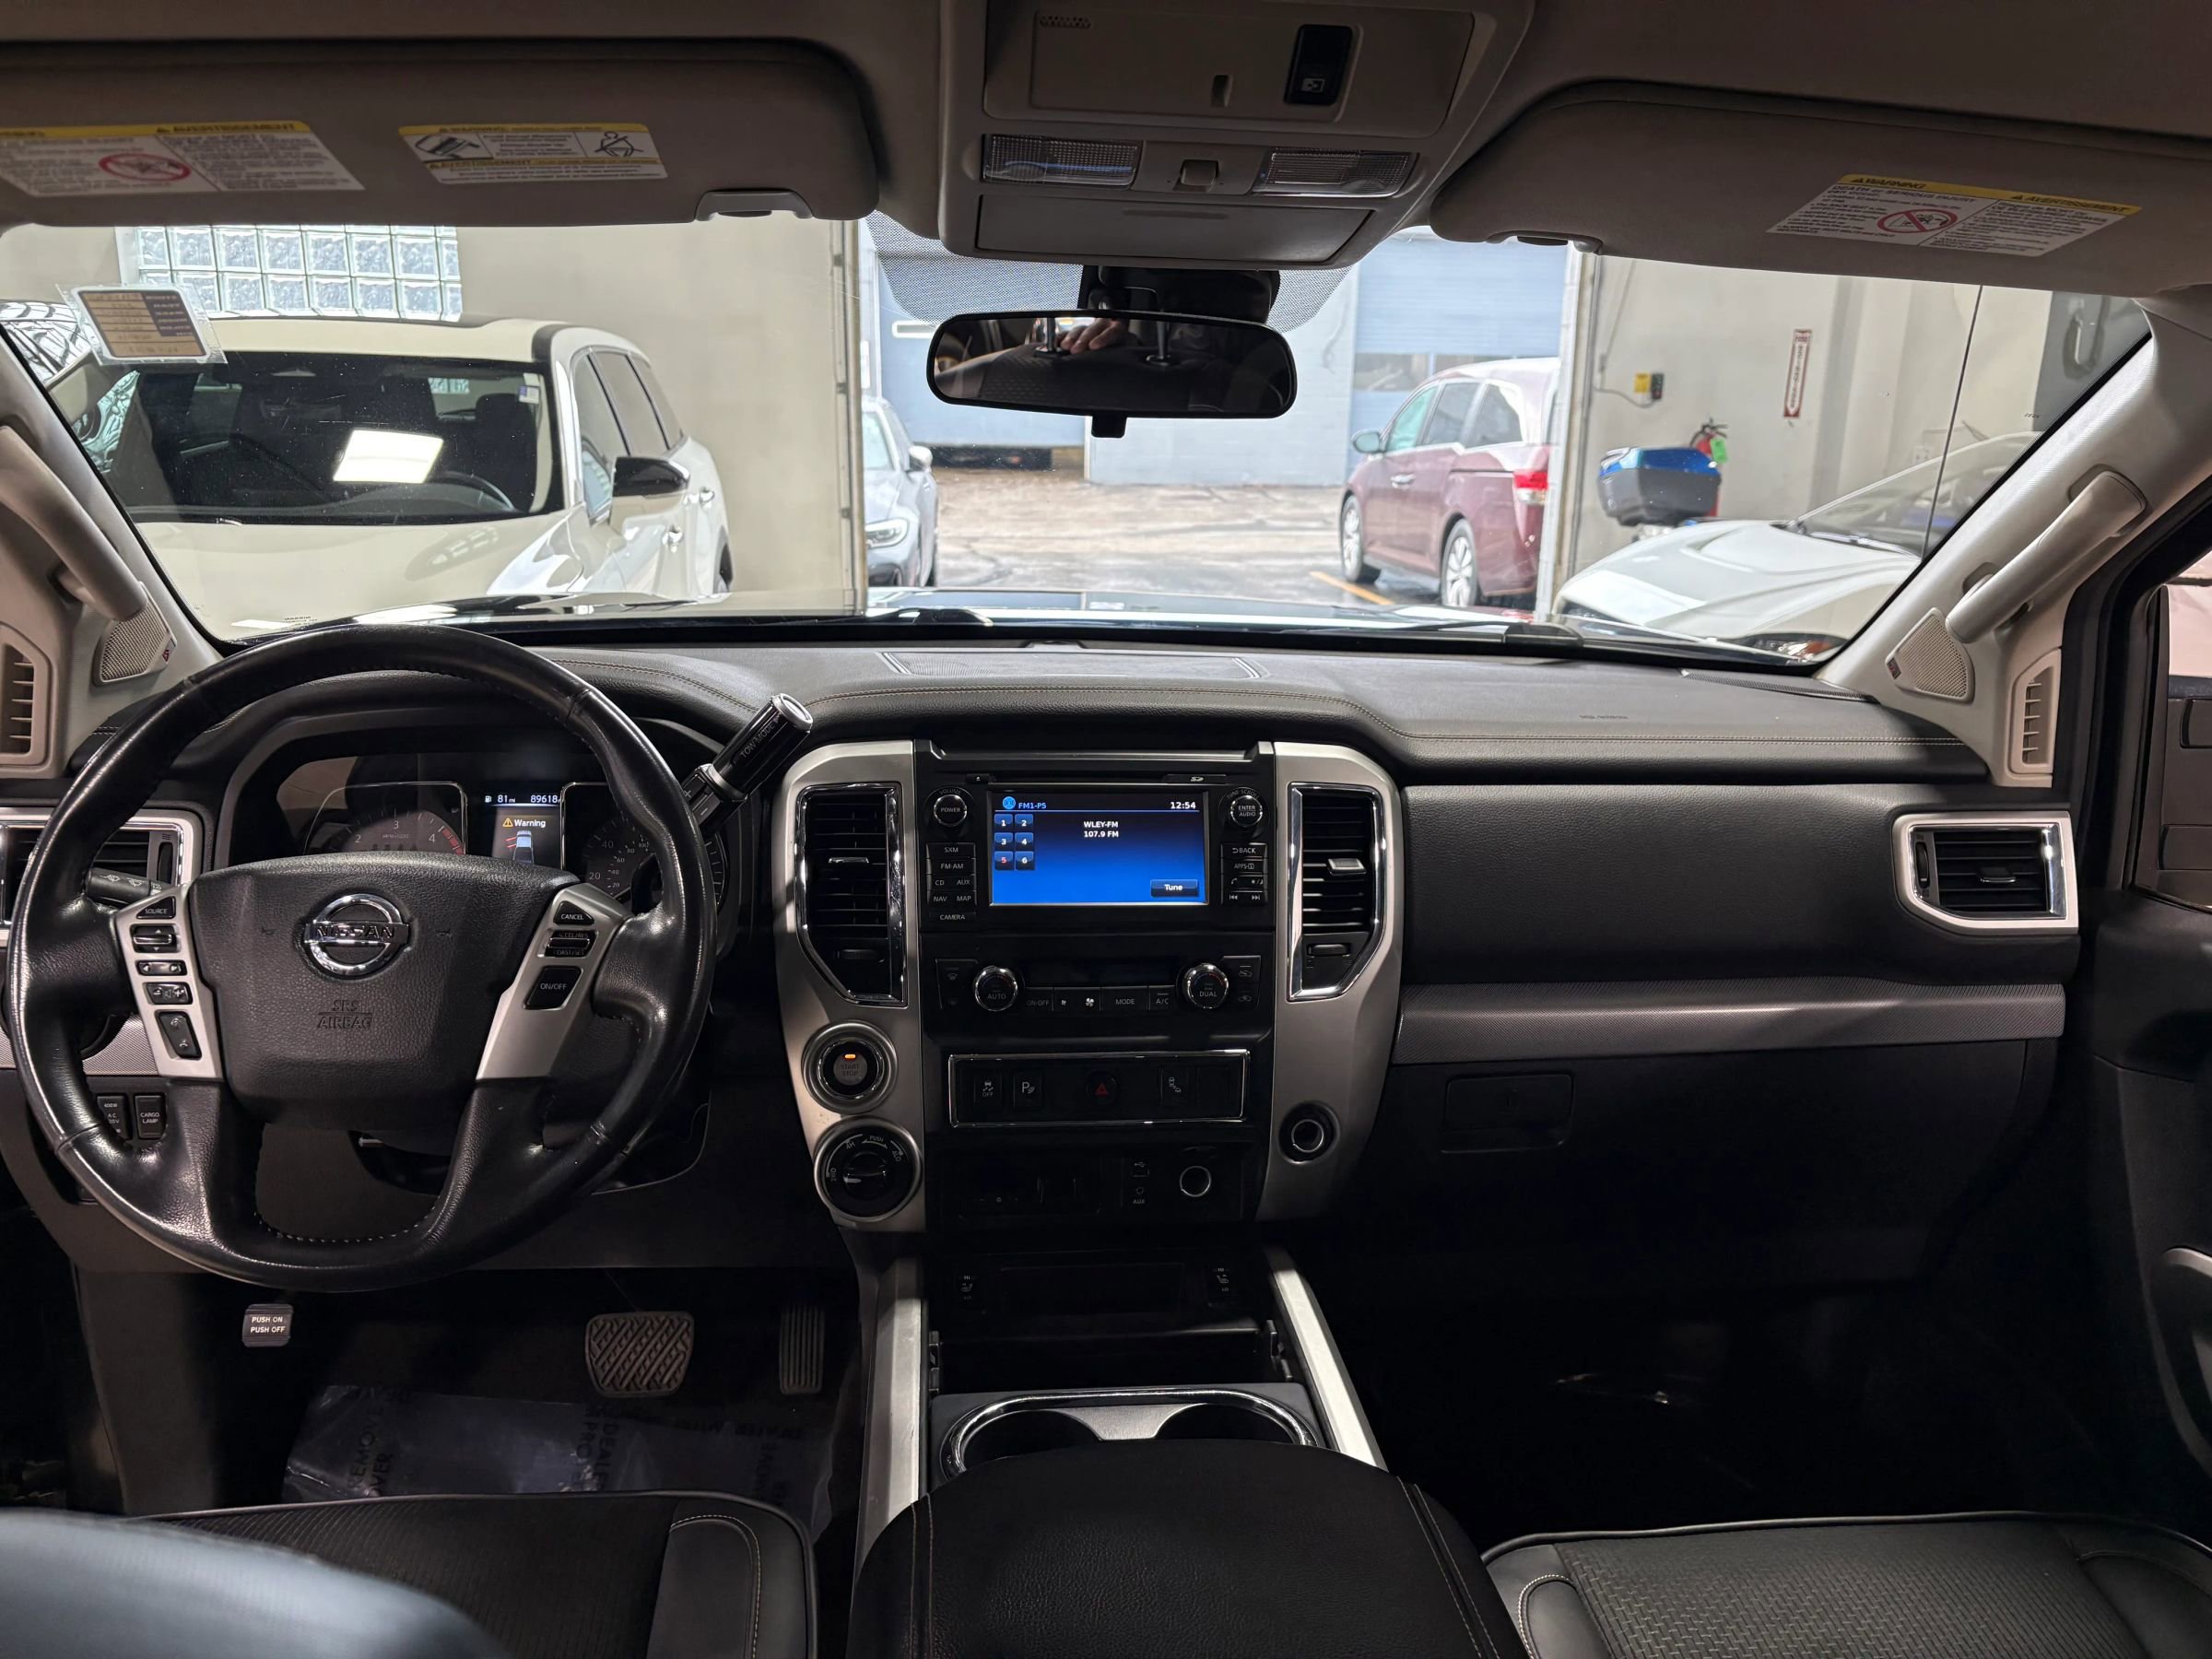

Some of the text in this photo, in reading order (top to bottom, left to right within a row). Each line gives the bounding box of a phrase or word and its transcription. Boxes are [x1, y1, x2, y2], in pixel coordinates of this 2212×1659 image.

[1171, 802, 1197, 810] 12:54
[394, 821, 399, 830] 3
[514, 819, 546, 829] Warning
[356, 834, 362, 843] 2
[429, 833, 436, 842] 4
[590, 872, 601, 880] 20
[317, 924, 396, 940] NISSAN
[333, 999, 359, 1012] SRS
[318, 1016, 371, 1030] AIRBAG
